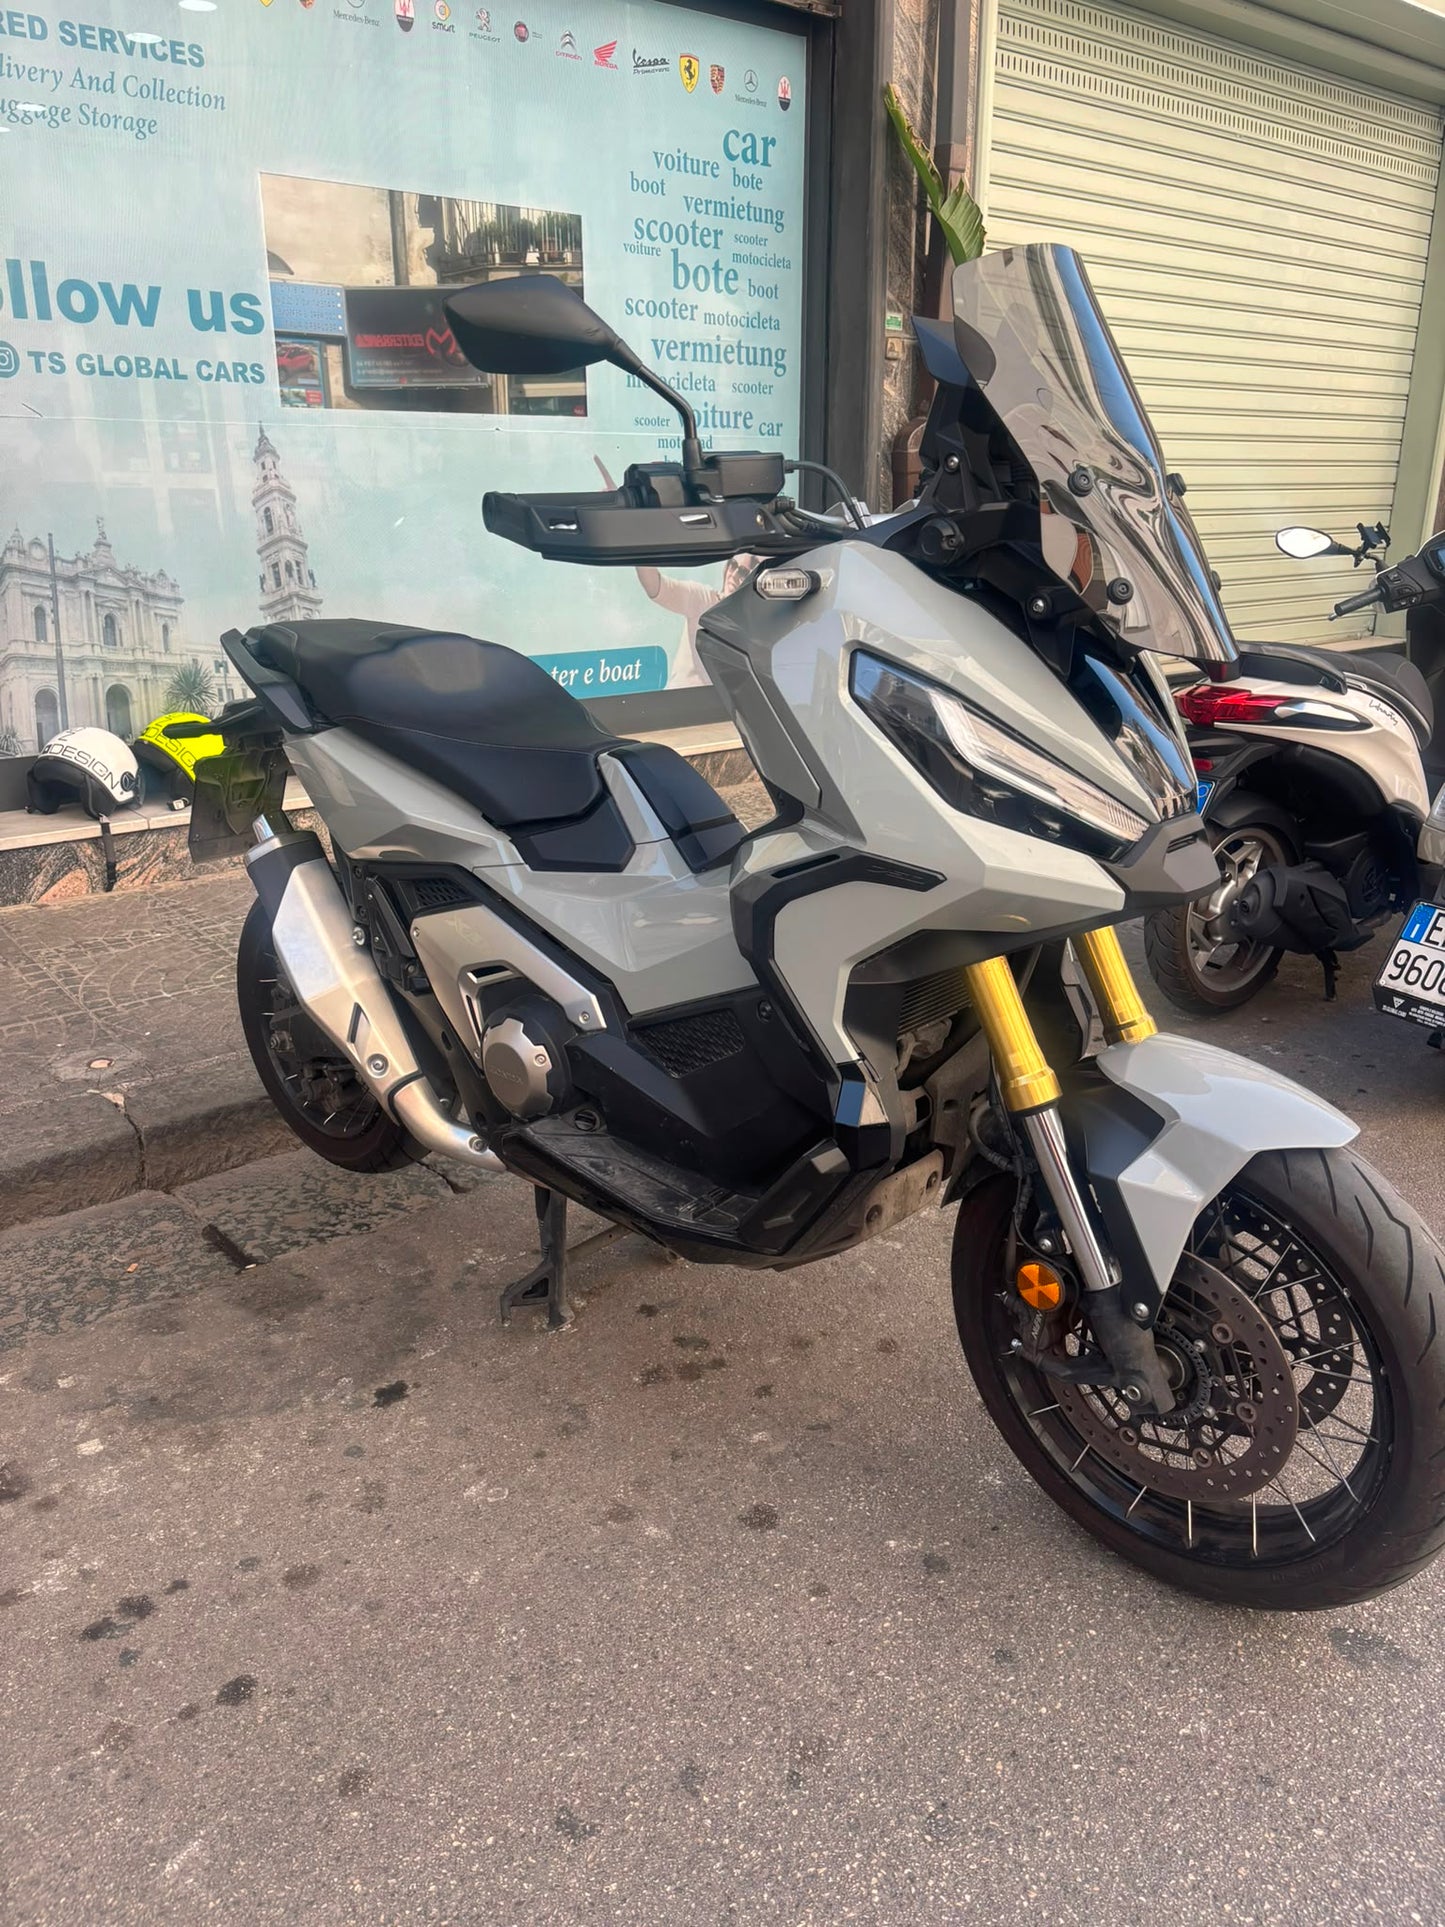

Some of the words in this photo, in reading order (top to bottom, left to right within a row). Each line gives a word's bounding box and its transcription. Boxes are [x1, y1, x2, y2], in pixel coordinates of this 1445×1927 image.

[431, 21, 455, 33] smart
[468, 32, 501, 43] PEUGEOT
[59, 20, 205, 68] SERVICES
[594, 60, 618, 70] HONDA
[632, 48, 670, 68] Vespa
[70, 67, 116, 94] And
[123, 74, 227, 111] Collection
[79, 103, 158, 141] Storage
[723, 129, 777, 167] car
[653, 148, 720, 178] voiture
[630, 171, 666, 196] boot
[732, 167, 763, 191] bote
[683, 195, 785, 233] vermietung
[634, 217, 723, 249] scooter
[734, 233, 768, 247] scooter
[623, 241, 661, 257] voiture
[732, 252, 791, 270] motocicleta
[671, 248, 738, 295] bote
[0, 258, 161, 327] llow
[187, 289, 265, 335] us
[748, 279, 779, 299] boot
[625, 297, 698, 321] scooter
[704, 311, 780, 331] motocicleta
[27, 351, 66, 374] TS
[76, 353, 188, 380] GLOBAL
[196, 360, 265, 384] CARS
[651, 335, 787, 377] vermietung
[731, 381, 773, 395] scooter
[634, 415, 670, 427] scooter
[678, 401, 753, 429] oiture
[759, 421, 783, 437] car
[584, 667, 594, 685] e
[599, 658, 642, 683] boat
[49, 743, 119, 790] DESIGN
